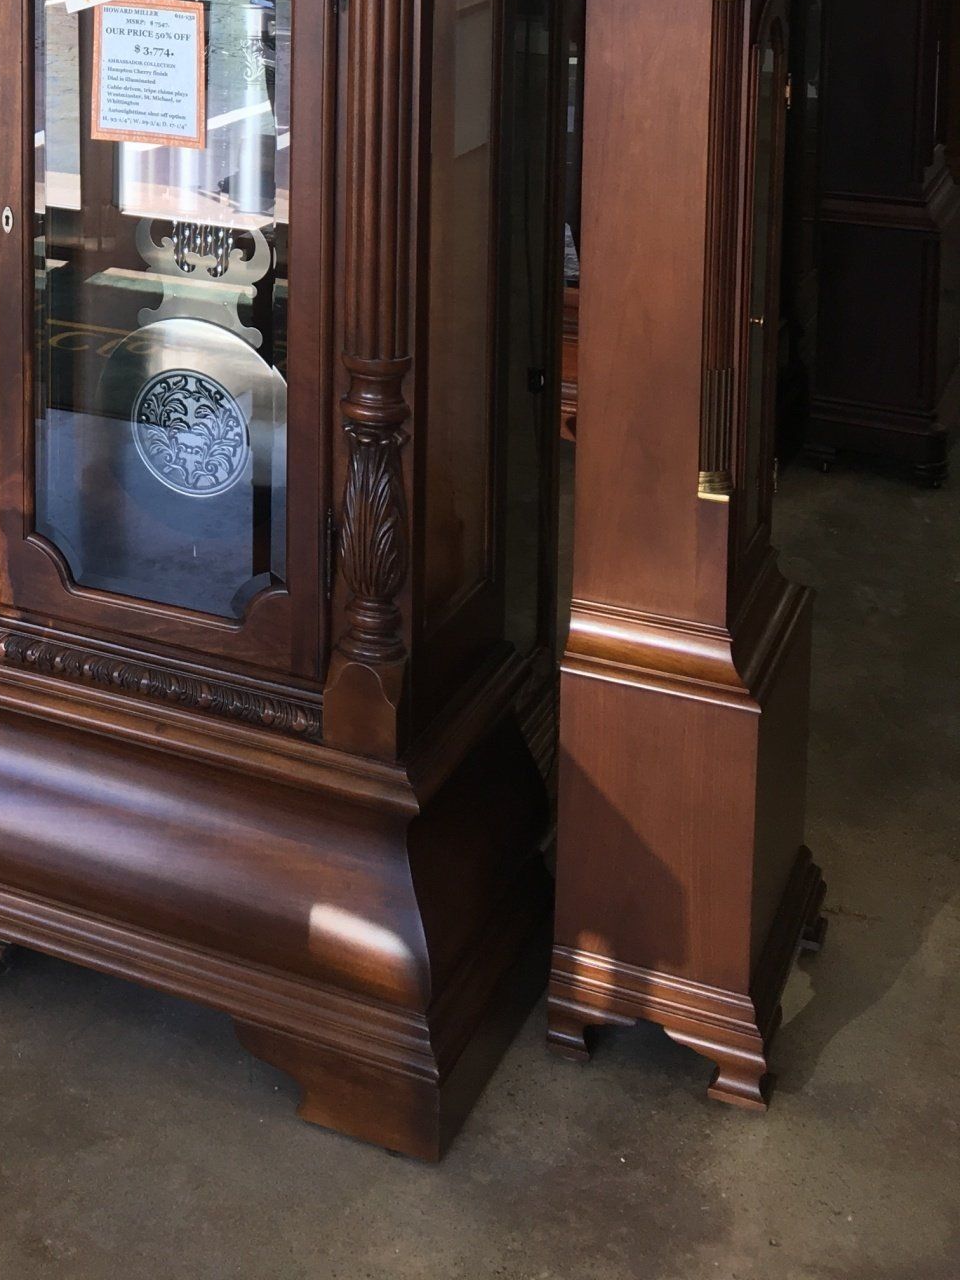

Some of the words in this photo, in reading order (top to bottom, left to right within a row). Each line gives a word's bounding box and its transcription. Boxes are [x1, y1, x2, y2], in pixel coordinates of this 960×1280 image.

[134, 9, 159, 17] MILLER
[105, 26, 125, 36] OUR
[127, 28, 153, 38] PRICE
[155, 31, 172, 40] 50%
[173, 32, 192, 41] OFF
[134, 43, 140, 54] $
